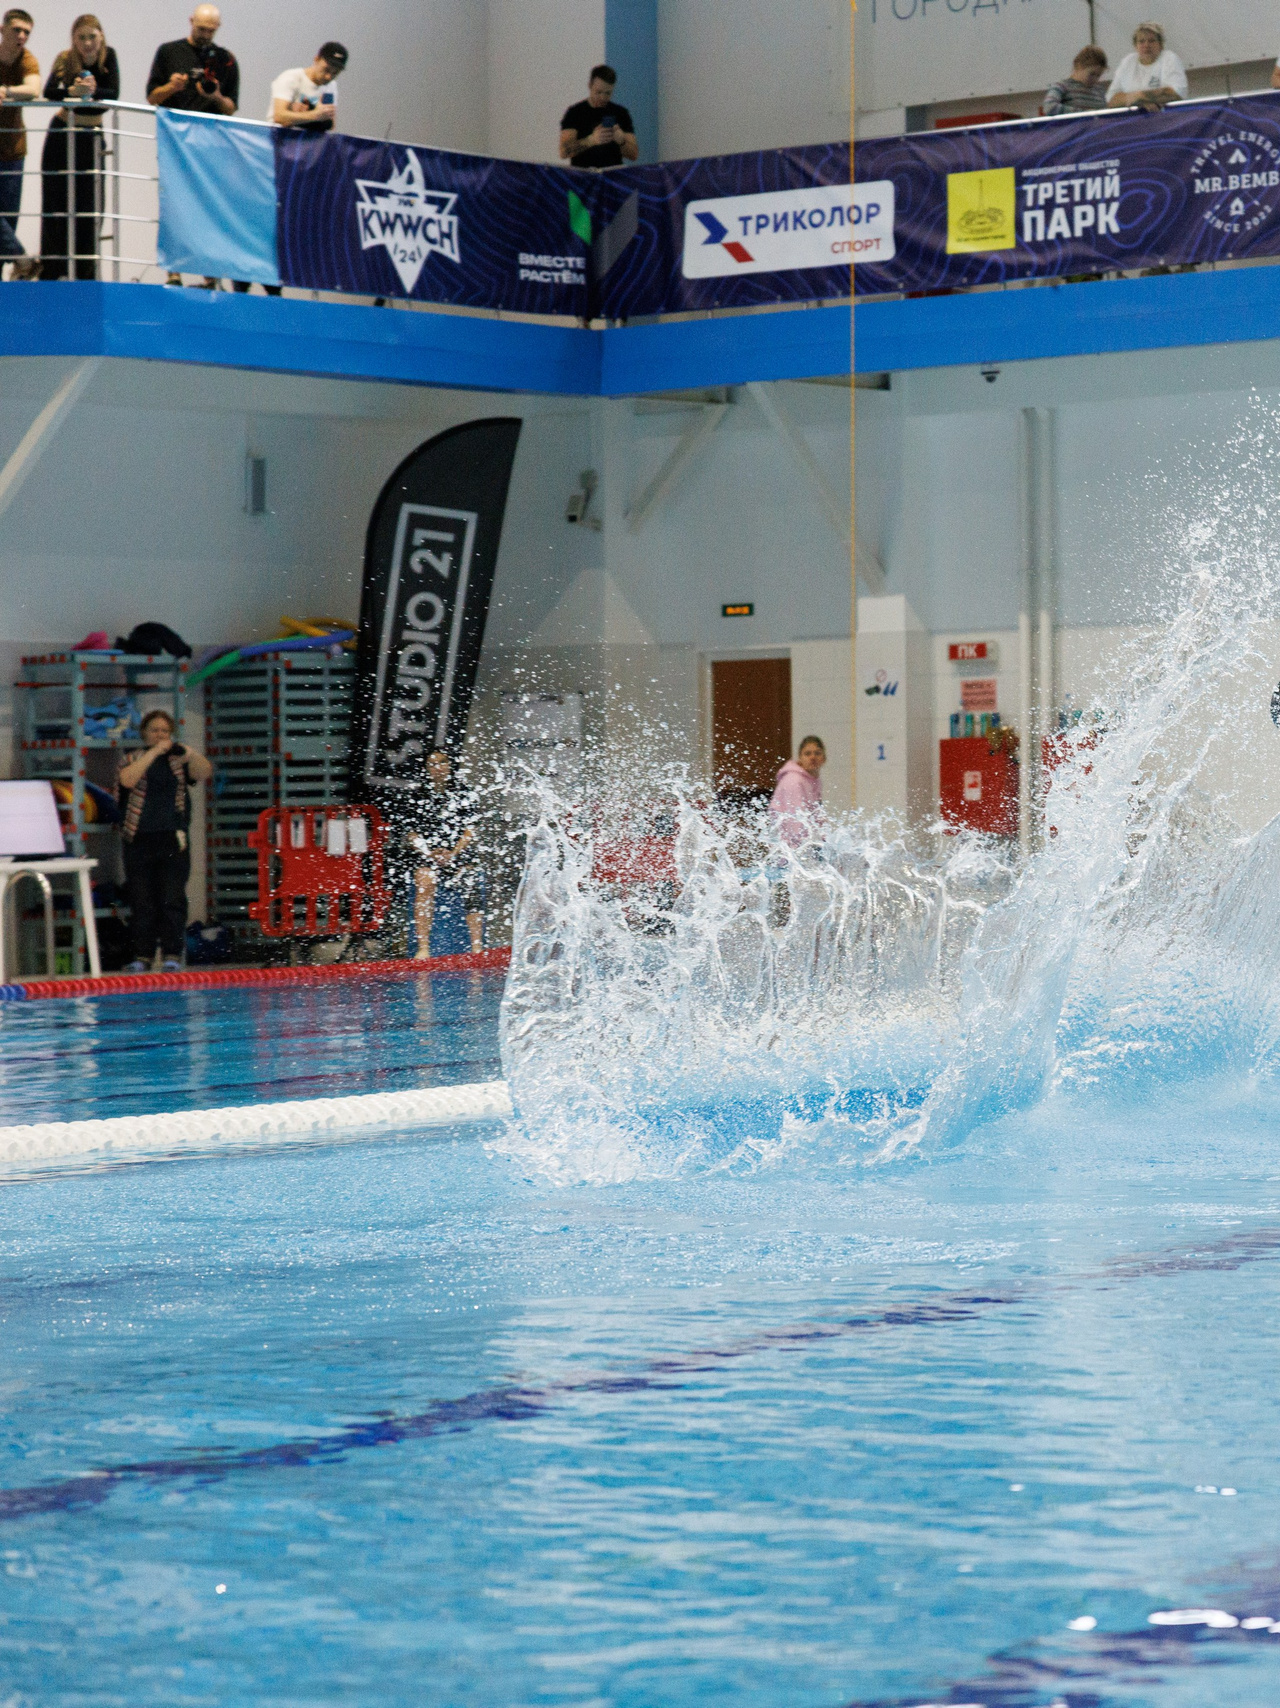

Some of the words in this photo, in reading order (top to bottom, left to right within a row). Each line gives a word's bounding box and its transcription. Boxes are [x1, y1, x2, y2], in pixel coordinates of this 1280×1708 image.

[1190, 133, 1234, 174] TRAVEL
[1022, 168, 1120, 207] ТРЕТИЙ
[1194, 170, 1280, 194] MR.BEMB
[361, 206, 455, 255] KWWCH
[738, 202, 882, 236] ТРИКОЛОР
[1023, 201, 1120, 242] ПАРК
[1203, 210, 1240, 233] SINCE
[518, 252, 586, 269] ВМЕСТЕ
[831, 237, 882, 254] СПОРТ
[519, 269, 586, 285] РАСТЁМ
[408, 528, 455, 579] 21
[384, 591, 445, 766] STUDIO
[877, 743, 887, 761] 1
